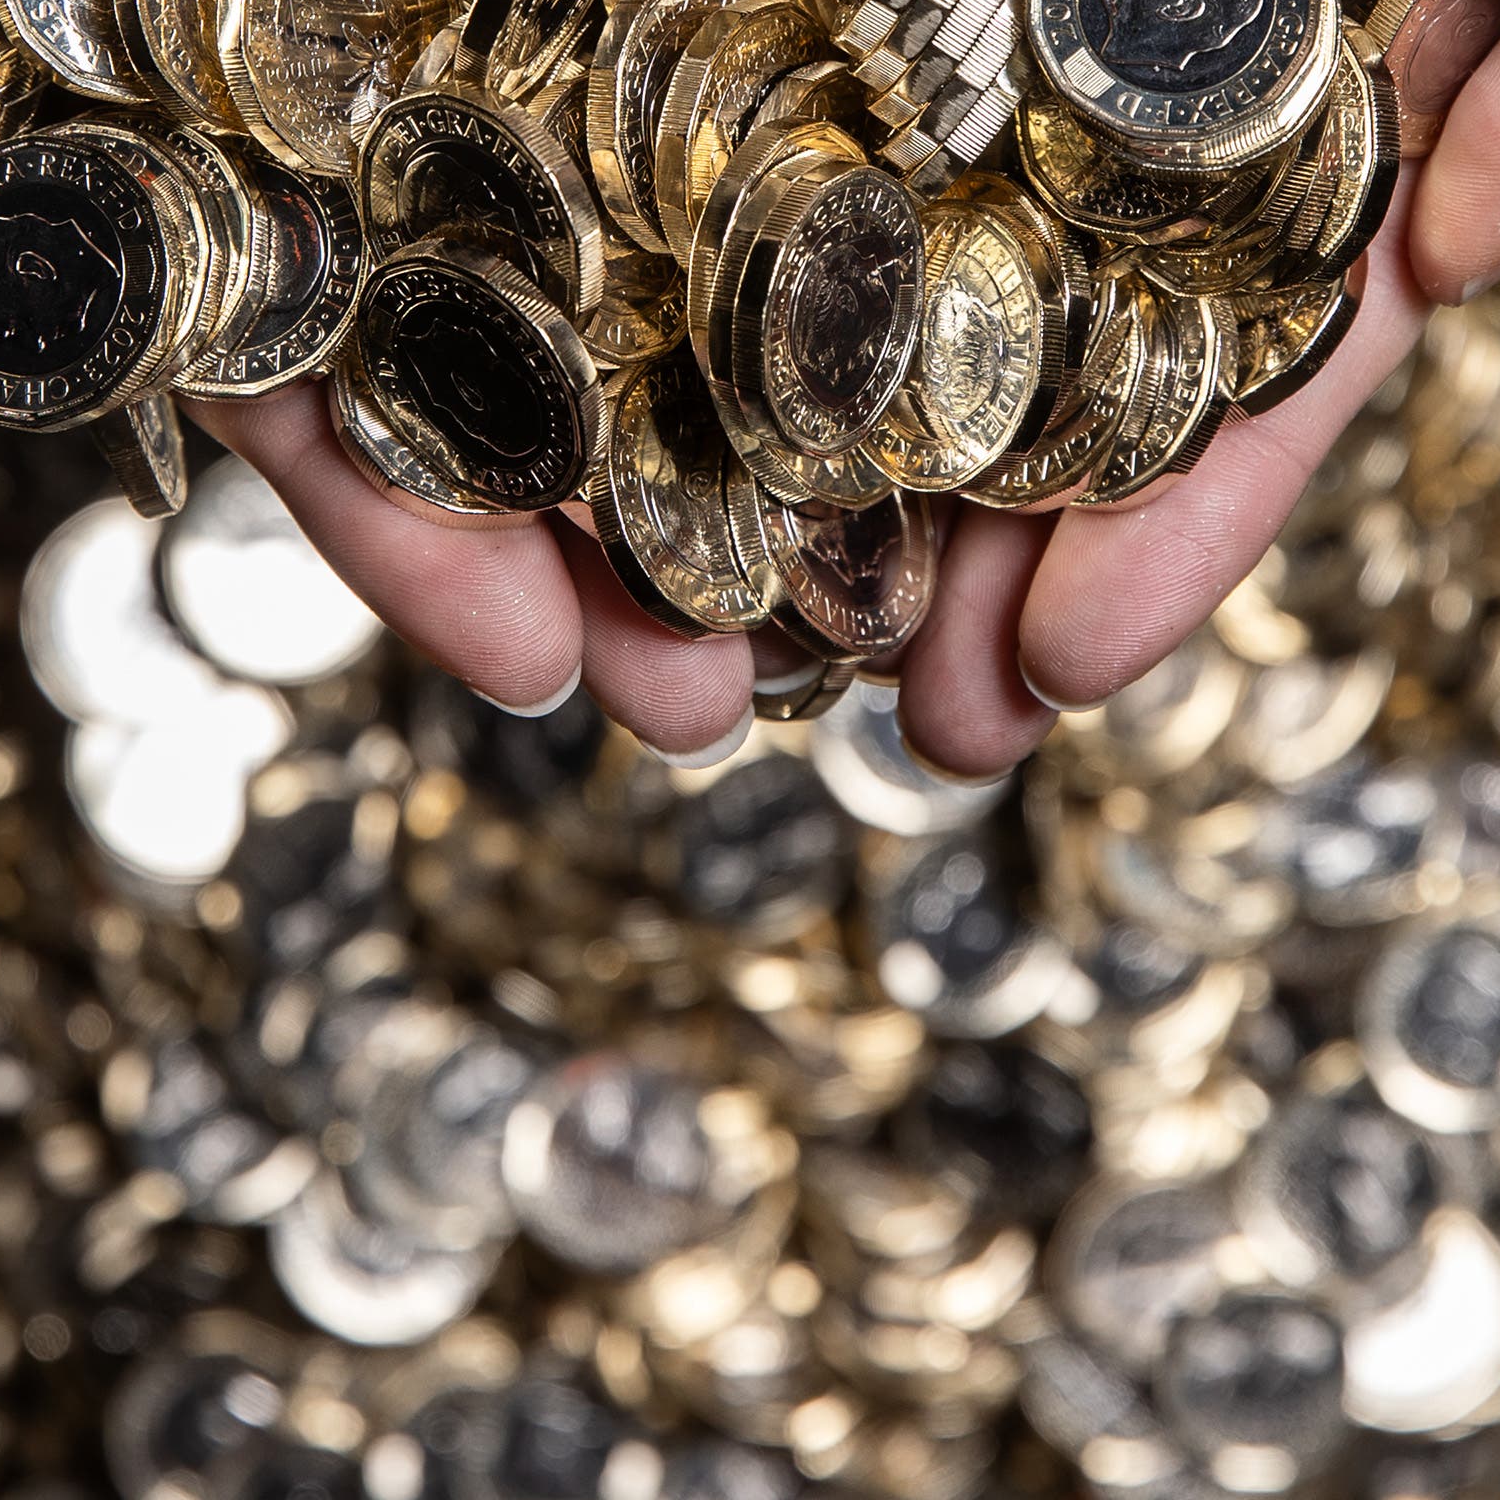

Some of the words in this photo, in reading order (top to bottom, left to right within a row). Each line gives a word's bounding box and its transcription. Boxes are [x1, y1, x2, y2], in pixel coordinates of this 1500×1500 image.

[1253, 14, 1305, 77] GRA
[264, 56, 332, 86] POUND
[625, 35, 655, 103] GRA
[1116, 92, 1144, 119] D
[1155, 99, 1173, 125] F
[1189, 77, 1257, 125] REX
[37, 151, 101, 192] REX
[381, 114, 423, 158] DEI
[425, 108, 484, 146] GRA
[491, 133, 546, 199] REX
[536, 205, 561, 223] F
[101, 180, 126, 204] F
[117, 206, 142, 232] D
[324, 199, 358, 241] III
[319, 254, 359, 316] DEI
[383, 273, 441, 314] 2023
[82, 303, 146, 382] 2023
[260, 319, 327, 372] GRA
[1169, 357, 1205, 418] DEI
